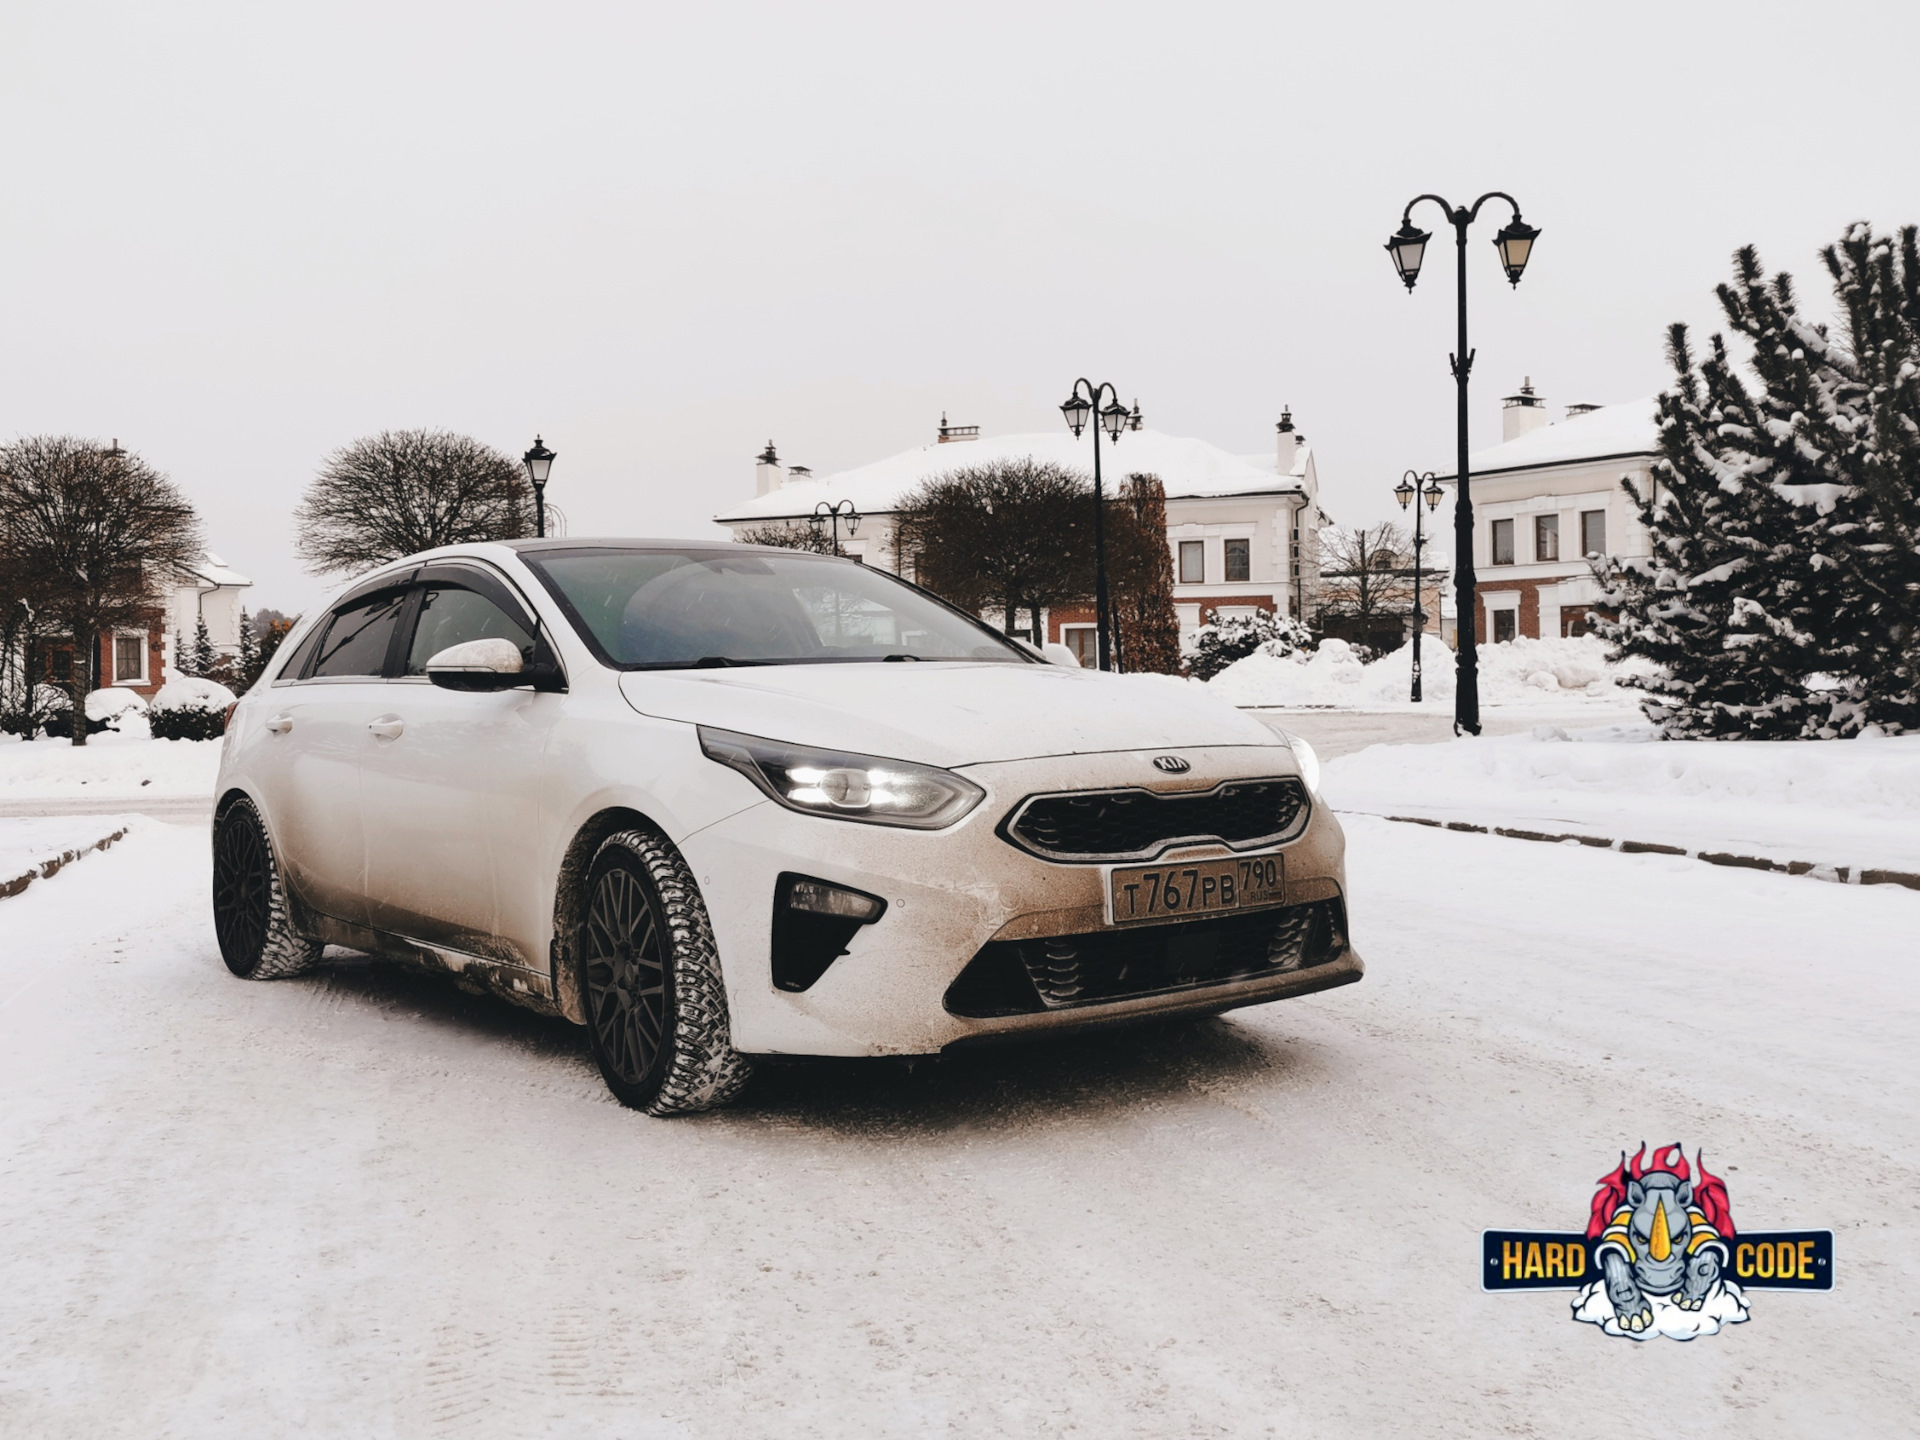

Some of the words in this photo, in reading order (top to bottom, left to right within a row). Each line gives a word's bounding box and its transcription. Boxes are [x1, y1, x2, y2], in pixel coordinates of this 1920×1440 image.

[1154, 756, 1189, 770] KIA
[1239, 859, 1277, 891] 790
[1250, 889, 1270, 902] RUS
